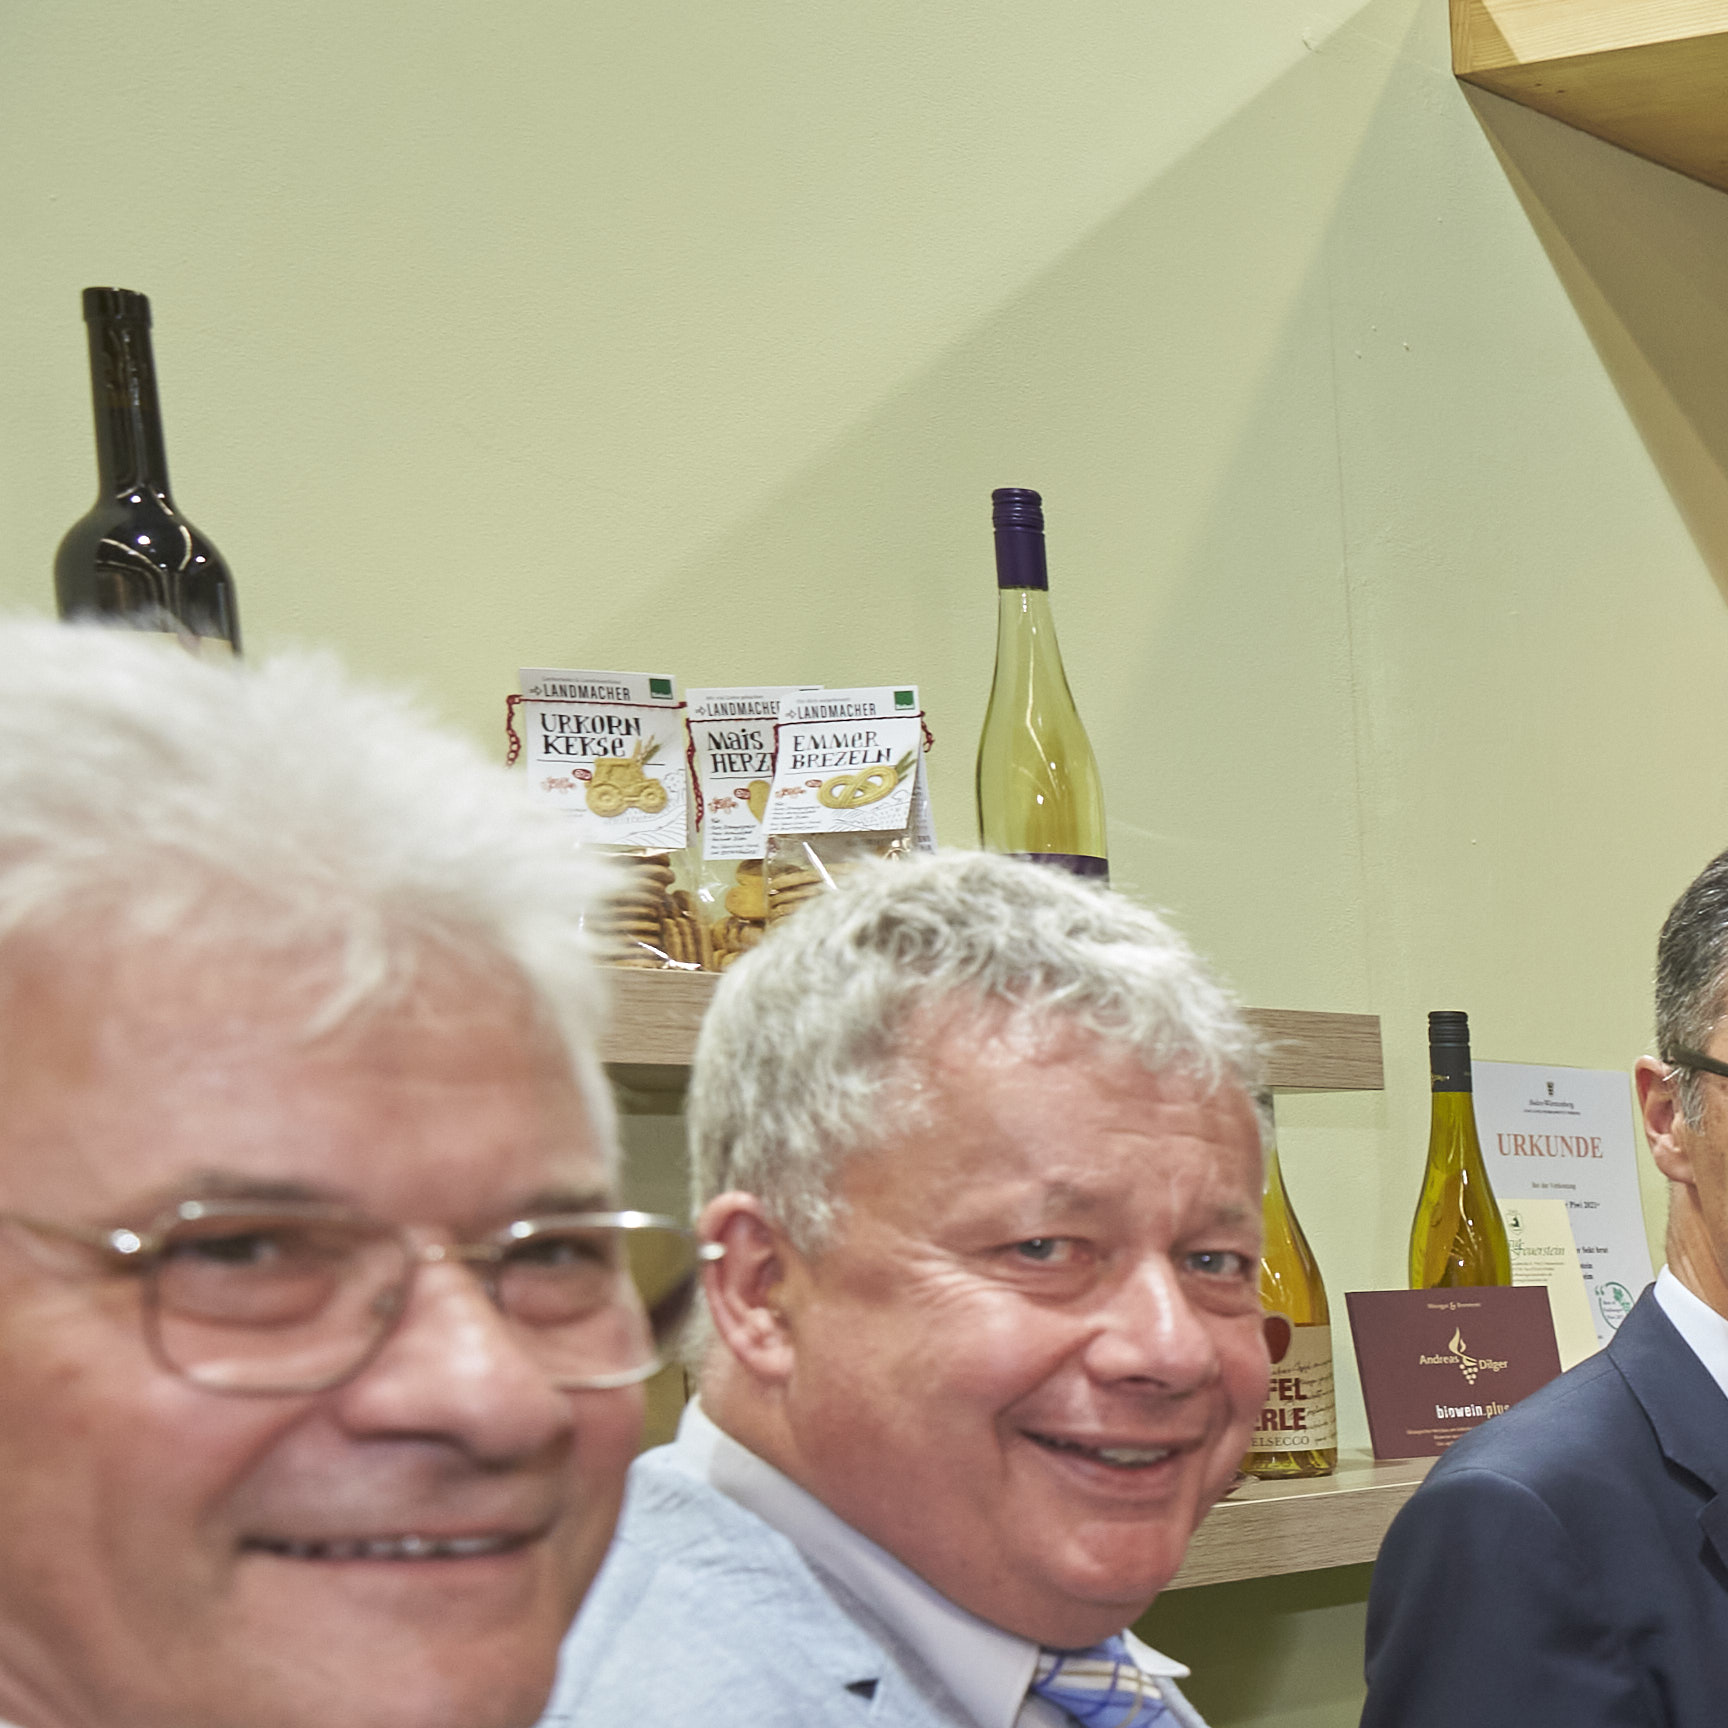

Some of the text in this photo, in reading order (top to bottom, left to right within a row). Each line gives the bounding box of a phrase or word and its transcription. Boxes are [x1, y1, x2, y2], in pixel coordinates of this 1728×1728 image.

[543, 683, 631, 702] LANDMACHER
[797, 702, 877, 720] LANDMACHER
[540, 713, 642, 736] URKORN
[711, 752, 774, 774] HERZ
[790, 748, 891, 770] BREZELN
[1497, 1132, 1604, 1159] URKUNDE
[1419, 1354, 1509, 1372] Andreas Dilger
[1251, 1436, 1310, 1447] ELSECCO
